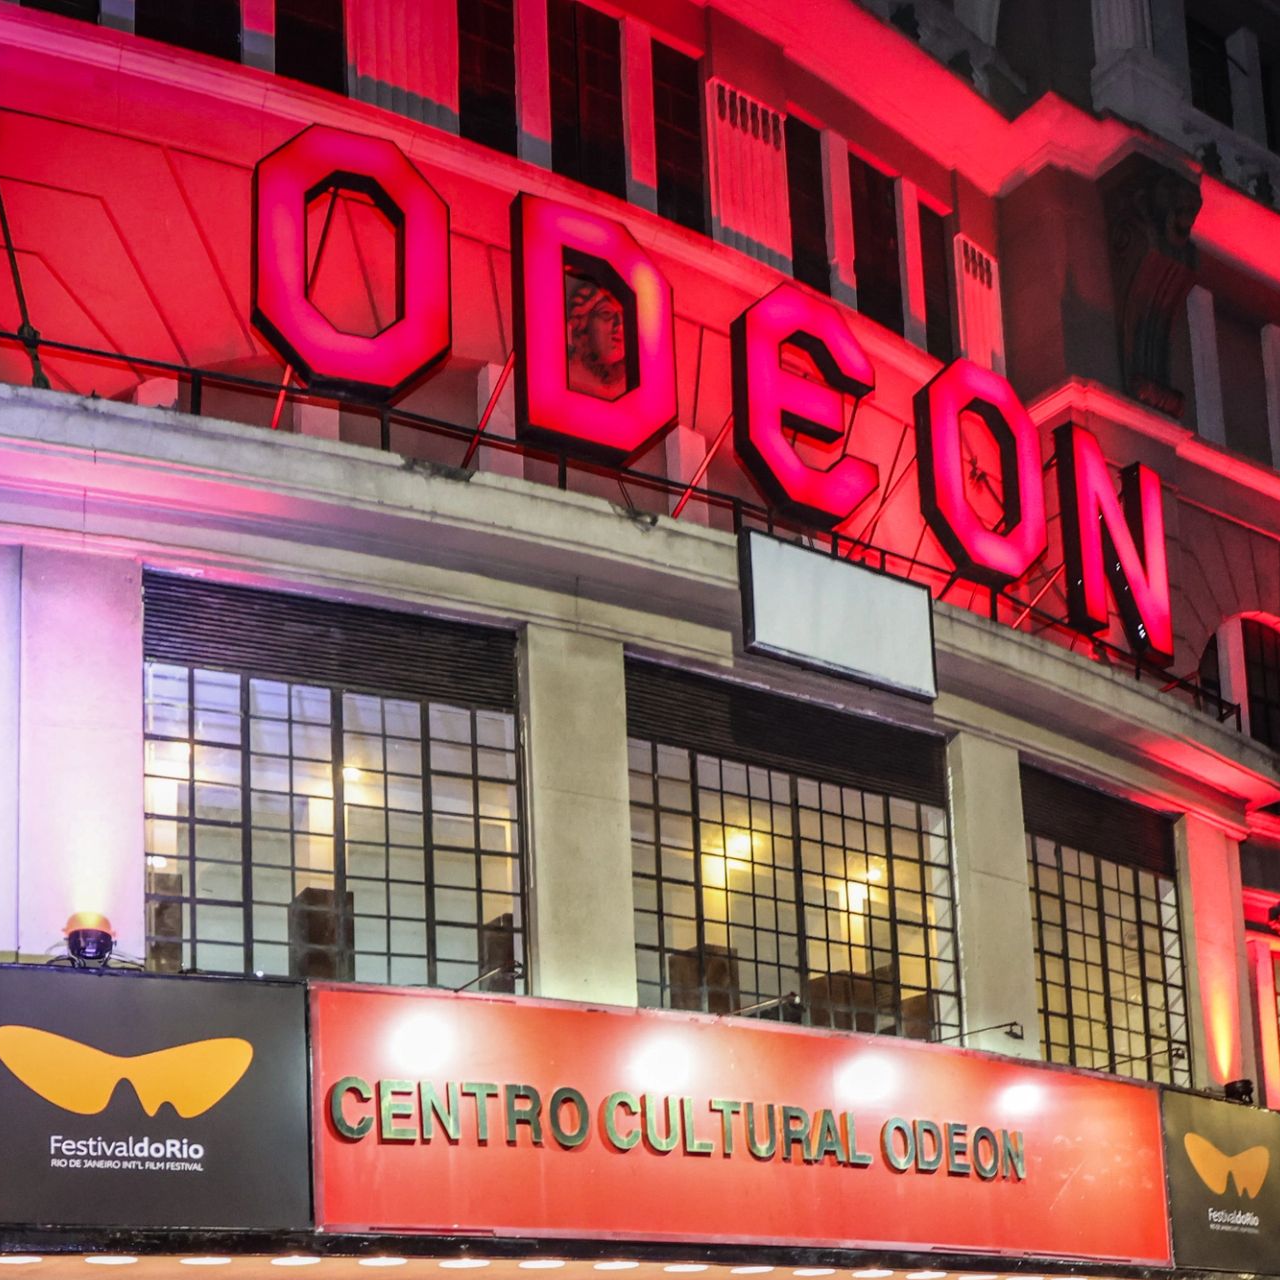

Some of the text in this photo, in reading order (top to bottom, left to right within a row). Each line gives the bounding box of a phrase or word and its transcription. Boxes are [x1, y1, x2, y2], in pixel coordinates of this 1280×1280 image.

[251, 123, 1174, 670] ODEON
[50, 1135, 204, 1159] FestivaldoRio
[330, 1075, 1025, 1179] CENTRO CULTURAL ODEON
[51, 1159, 67, 1168] RIO
[69, 1159, 81, 1168] DE
[84, 1160, 120, 1169] JANEIRO
[145, 1161, 164, 1170] FILM
[166, 1162, 204, 1171] FESTIVAL
